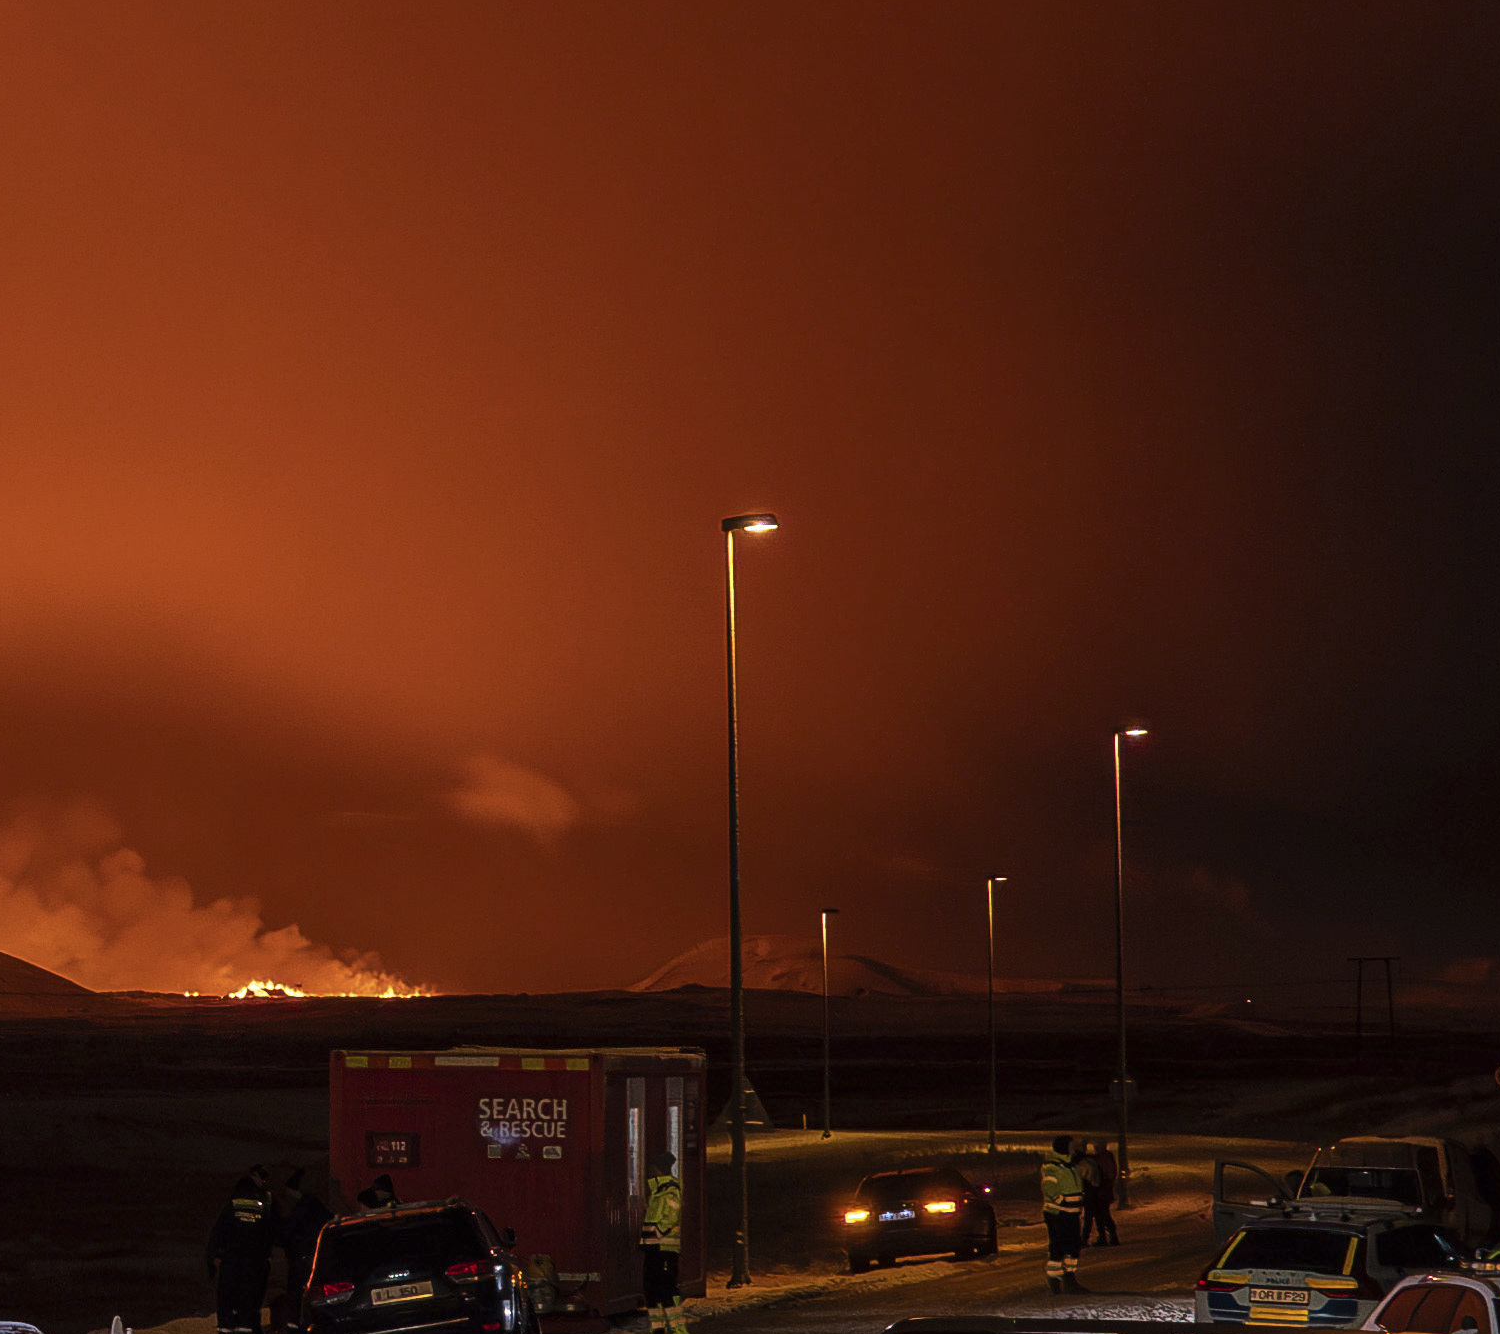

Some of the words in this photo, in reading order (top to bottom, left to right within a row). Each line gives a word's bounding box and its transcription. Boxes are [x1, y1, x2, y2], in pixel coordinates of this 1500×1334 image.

[479, 1098, 568, 1120] SEARCH
[480, 1121, 493, 1138] &
[499, 1121, 567, 1138] RESCUE
[1258, 1290, 1275, 1300] OR
